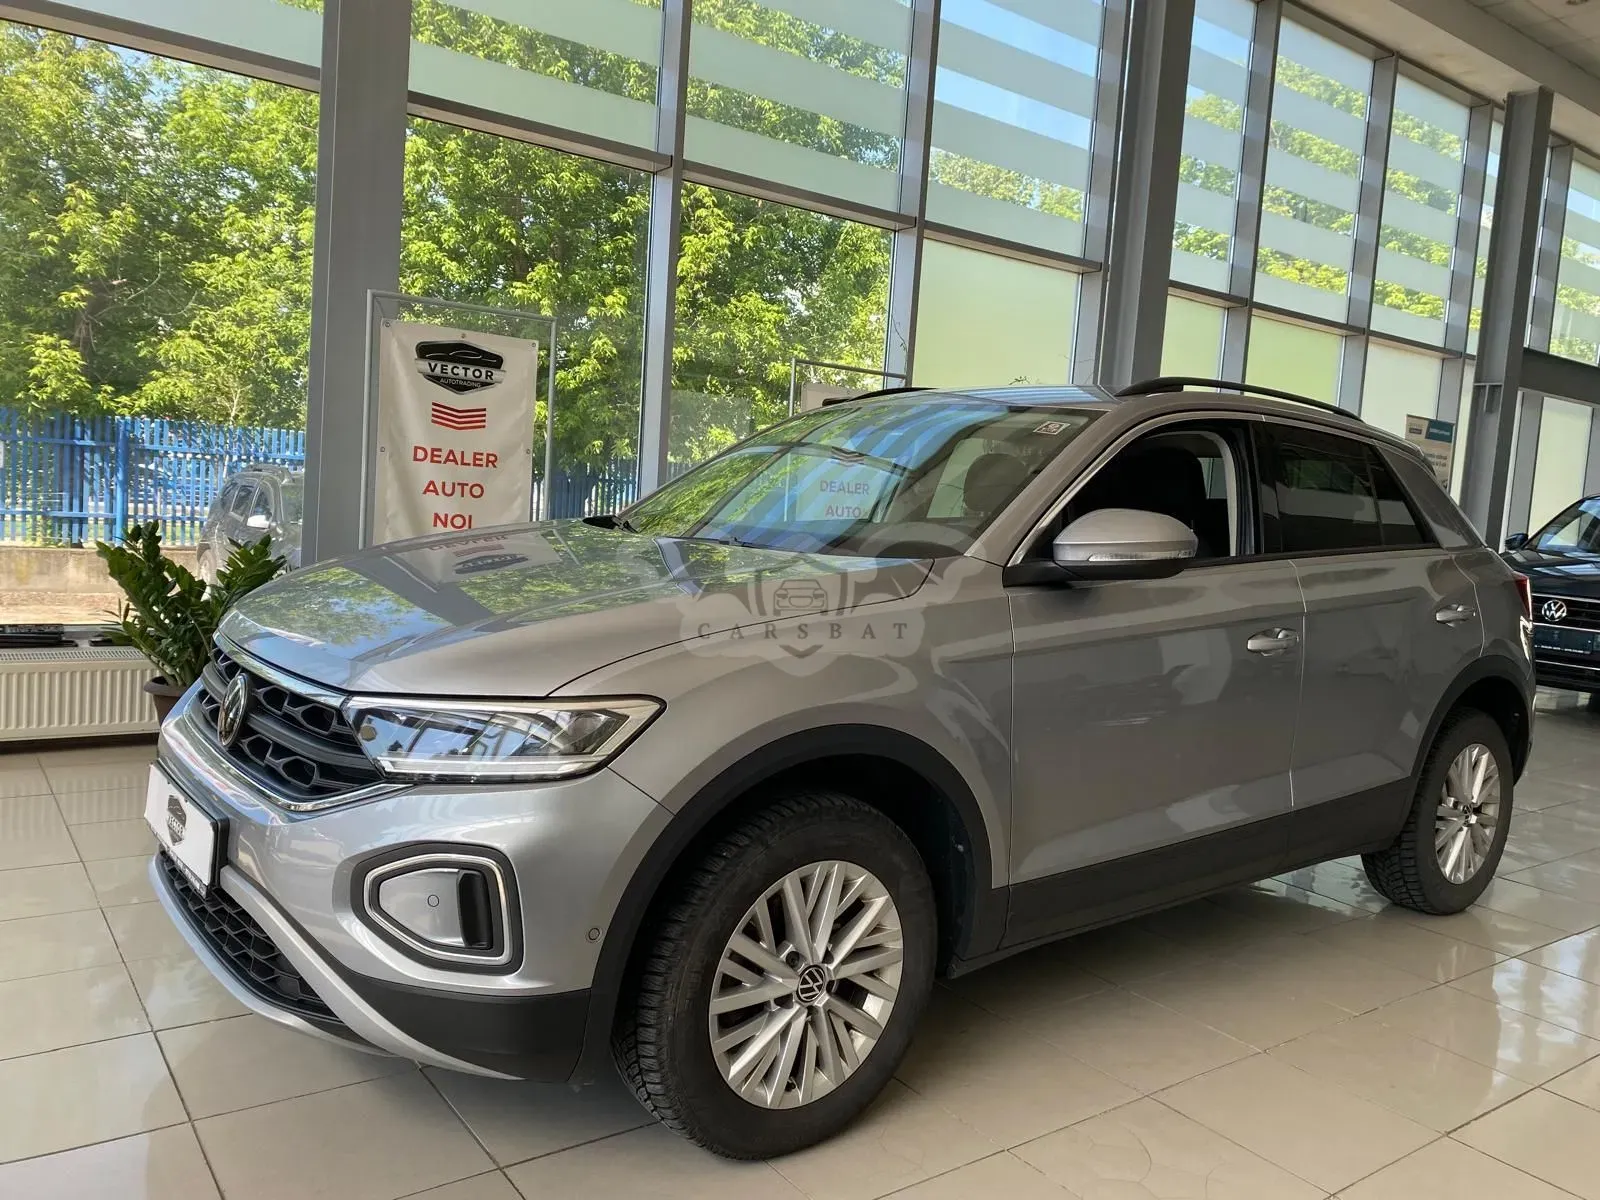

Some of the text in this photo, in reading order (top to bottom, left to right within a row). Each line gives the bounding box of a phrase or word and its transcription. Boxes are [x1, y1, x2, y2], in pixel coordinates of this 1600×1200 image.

[427, 362, 494, 381] VECTOR
[440, 378, 481, 388] AUTOTRADING
[413, 446, 498, 468] DEALER
[422, 479, 485, 499] AUTO
[819, 480, 870, 495] DEALER
[825, 504, 862, 519] AUTO
[433, 512, 473, 530] NOI
